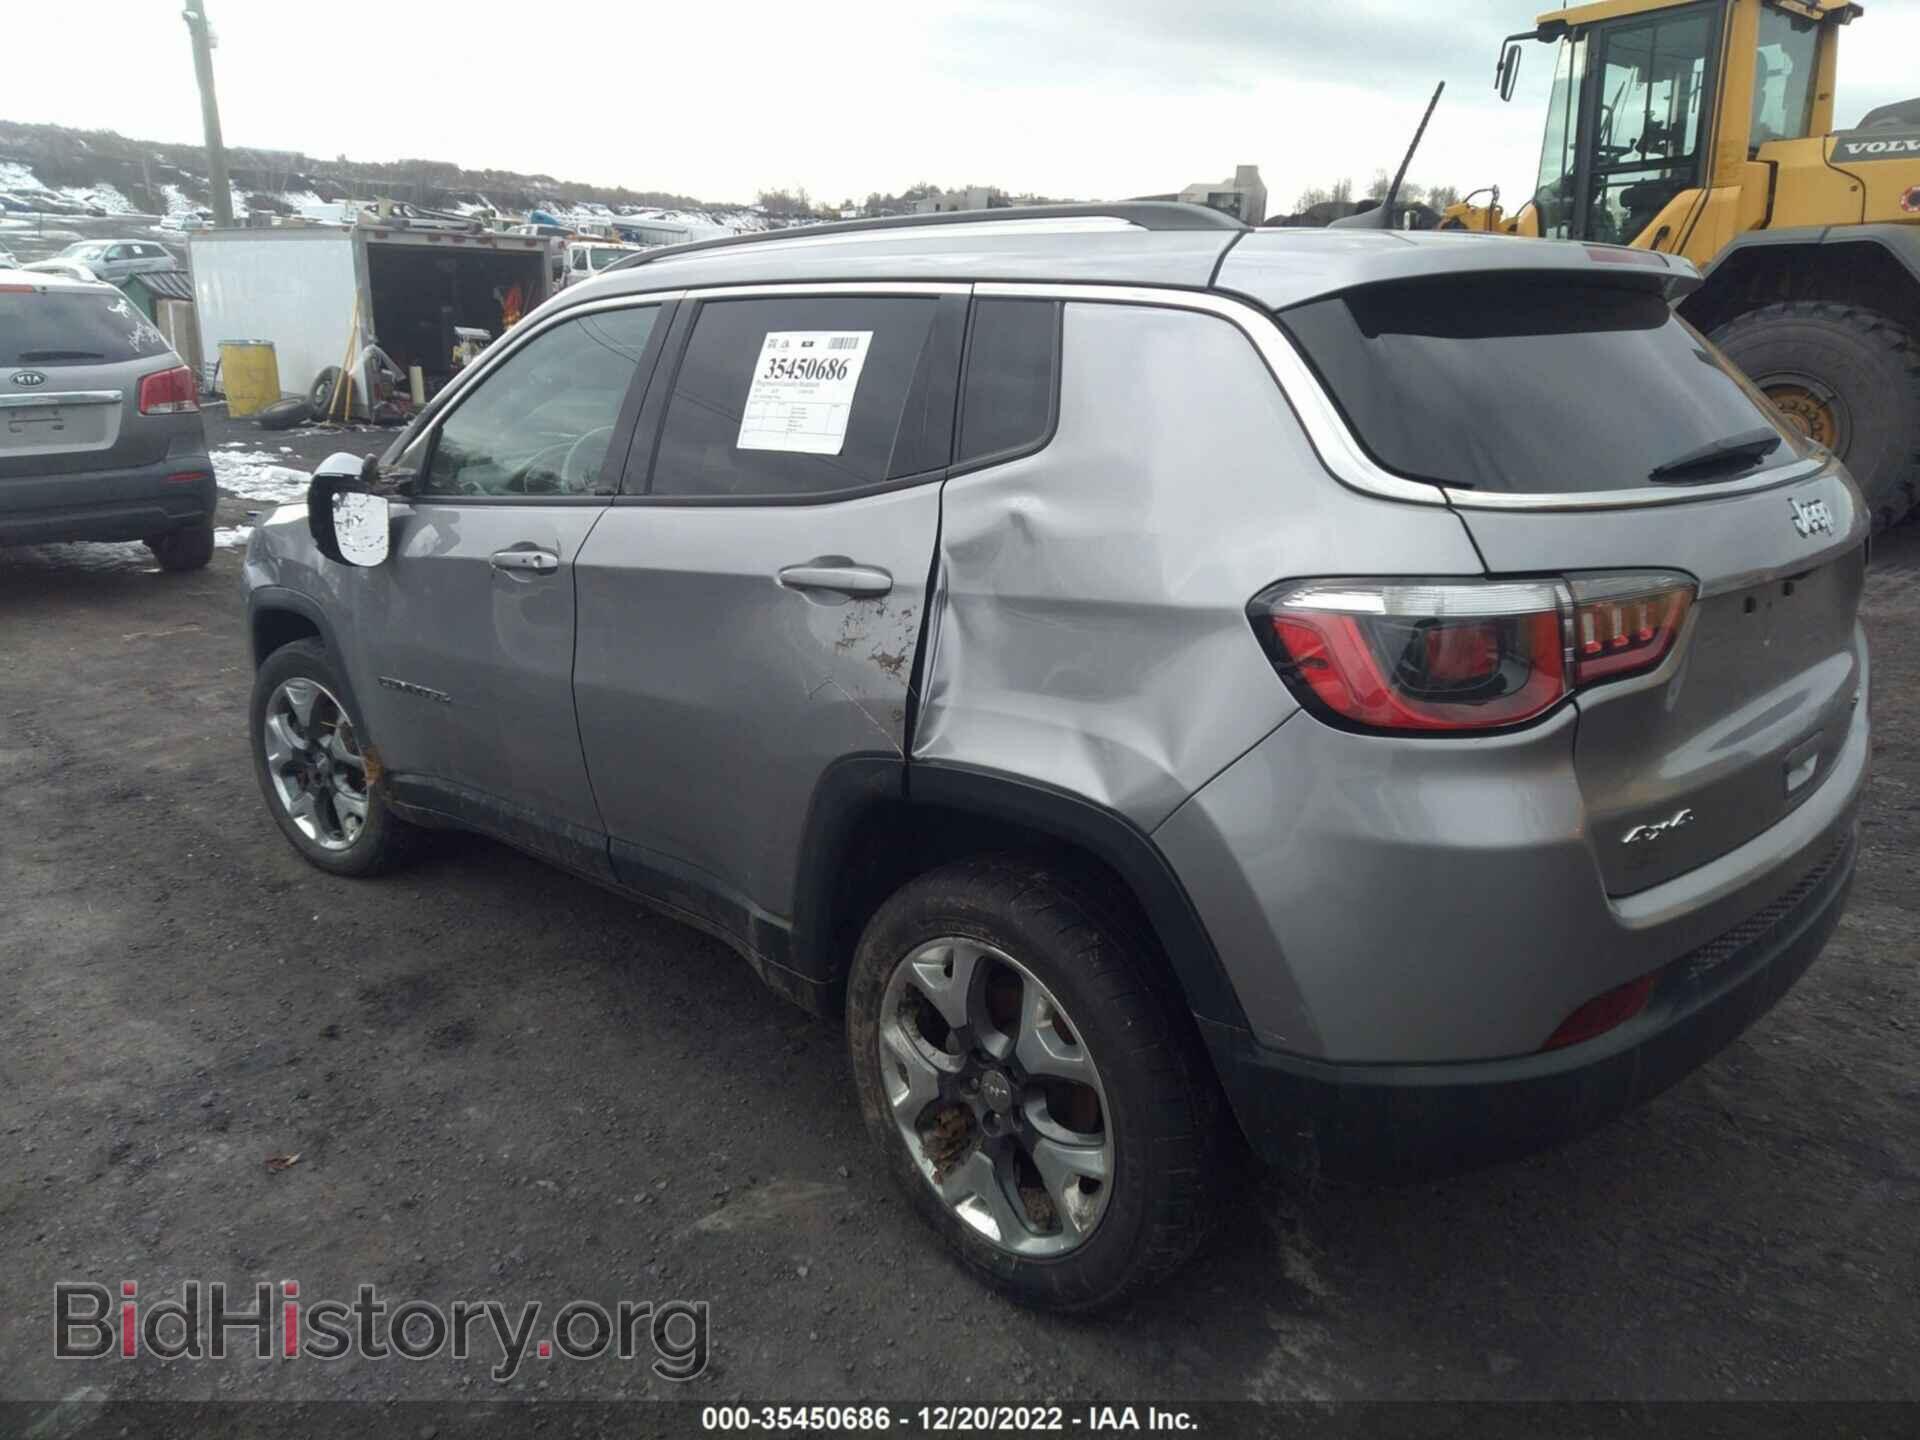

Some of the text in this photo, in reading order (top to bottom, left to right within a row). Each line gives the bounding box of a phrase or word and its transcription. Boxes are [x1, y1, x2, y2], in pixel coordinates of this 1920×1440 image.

[16, 375, 41, 386] KIA
[763, 357, 851, 381] 35450686
[1788, 498, 1833, 538] Jeep
